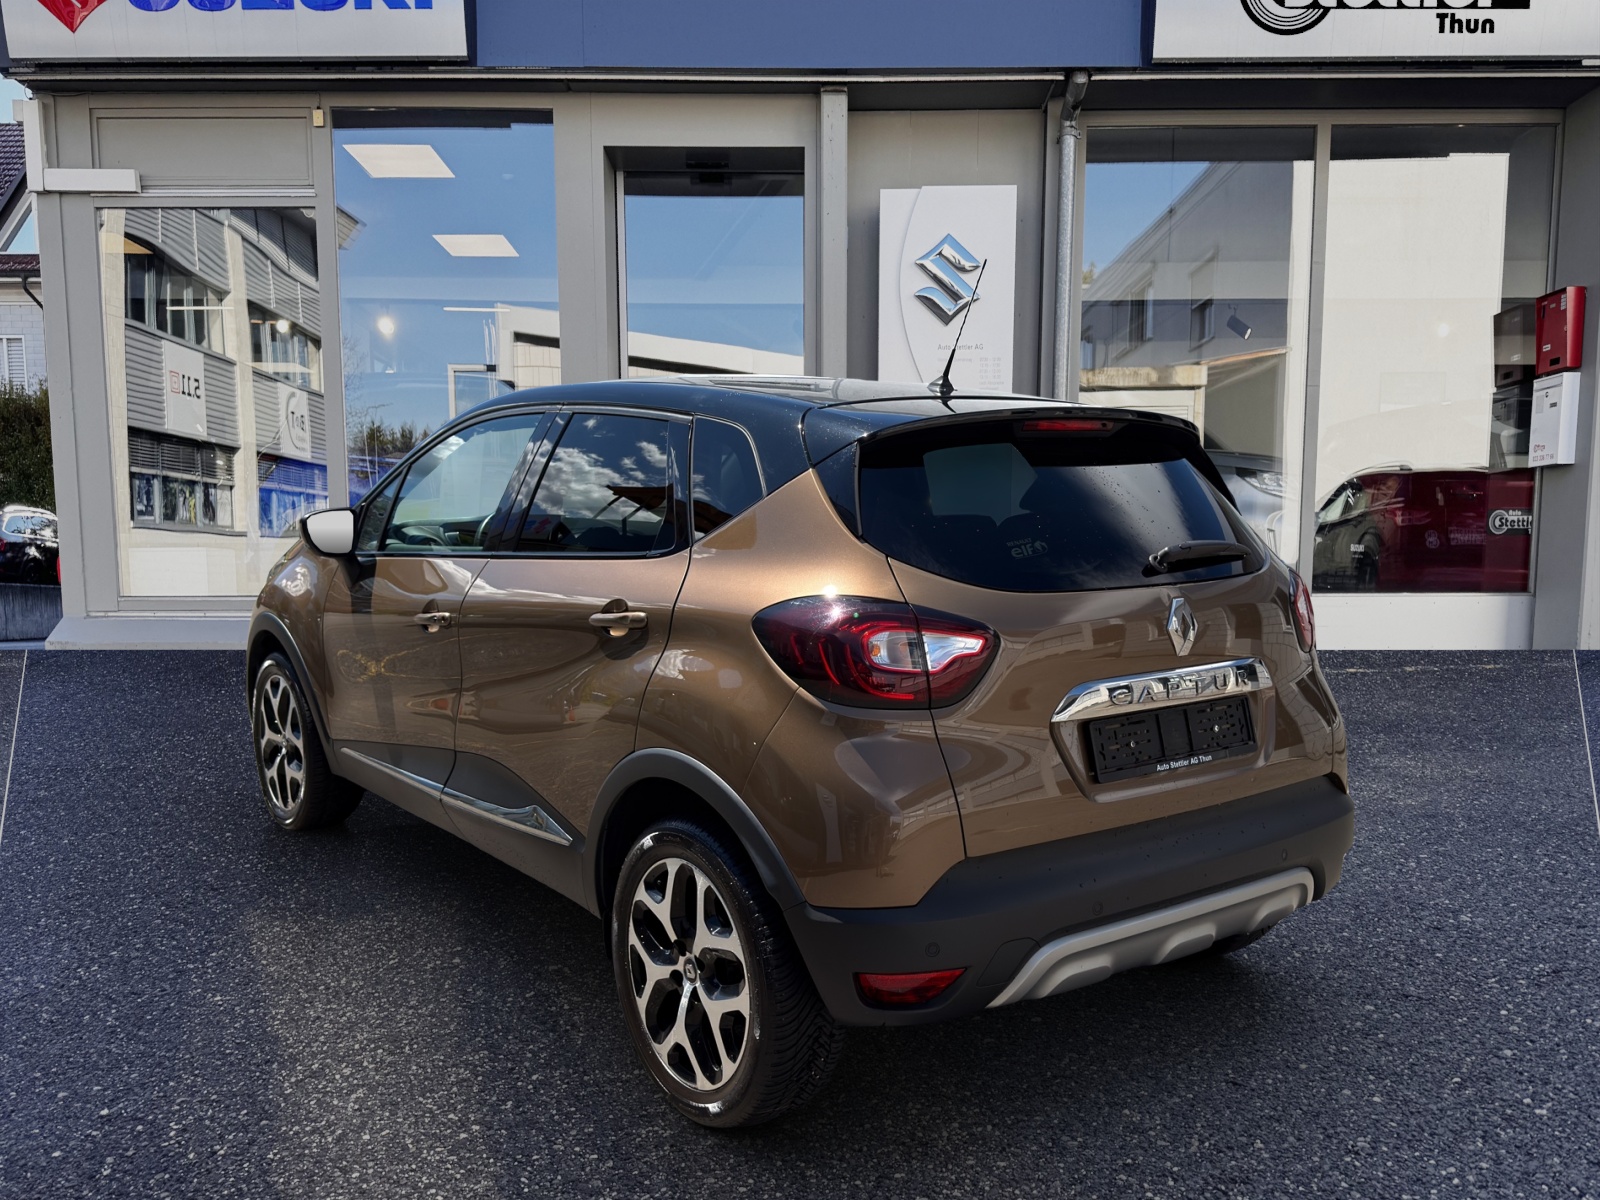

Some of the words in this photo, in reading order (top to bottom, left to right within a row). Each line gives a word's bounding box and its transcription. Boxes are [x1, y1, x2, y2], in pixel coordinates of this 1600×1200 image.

[1436, 13, 1495, 34] Thun
[1498, 516, 1532, 528] Stettl
[1011, 543, 1033, 557] elf
[1111, 670, 1249, 705] CAPTUR
[1156, 763, 1170, 771] Auto
[1170, 759, 1190, 769] Stettler
[1190, 756, 1199, 765] AG
[1199, 755, 1213, 763] Thun
